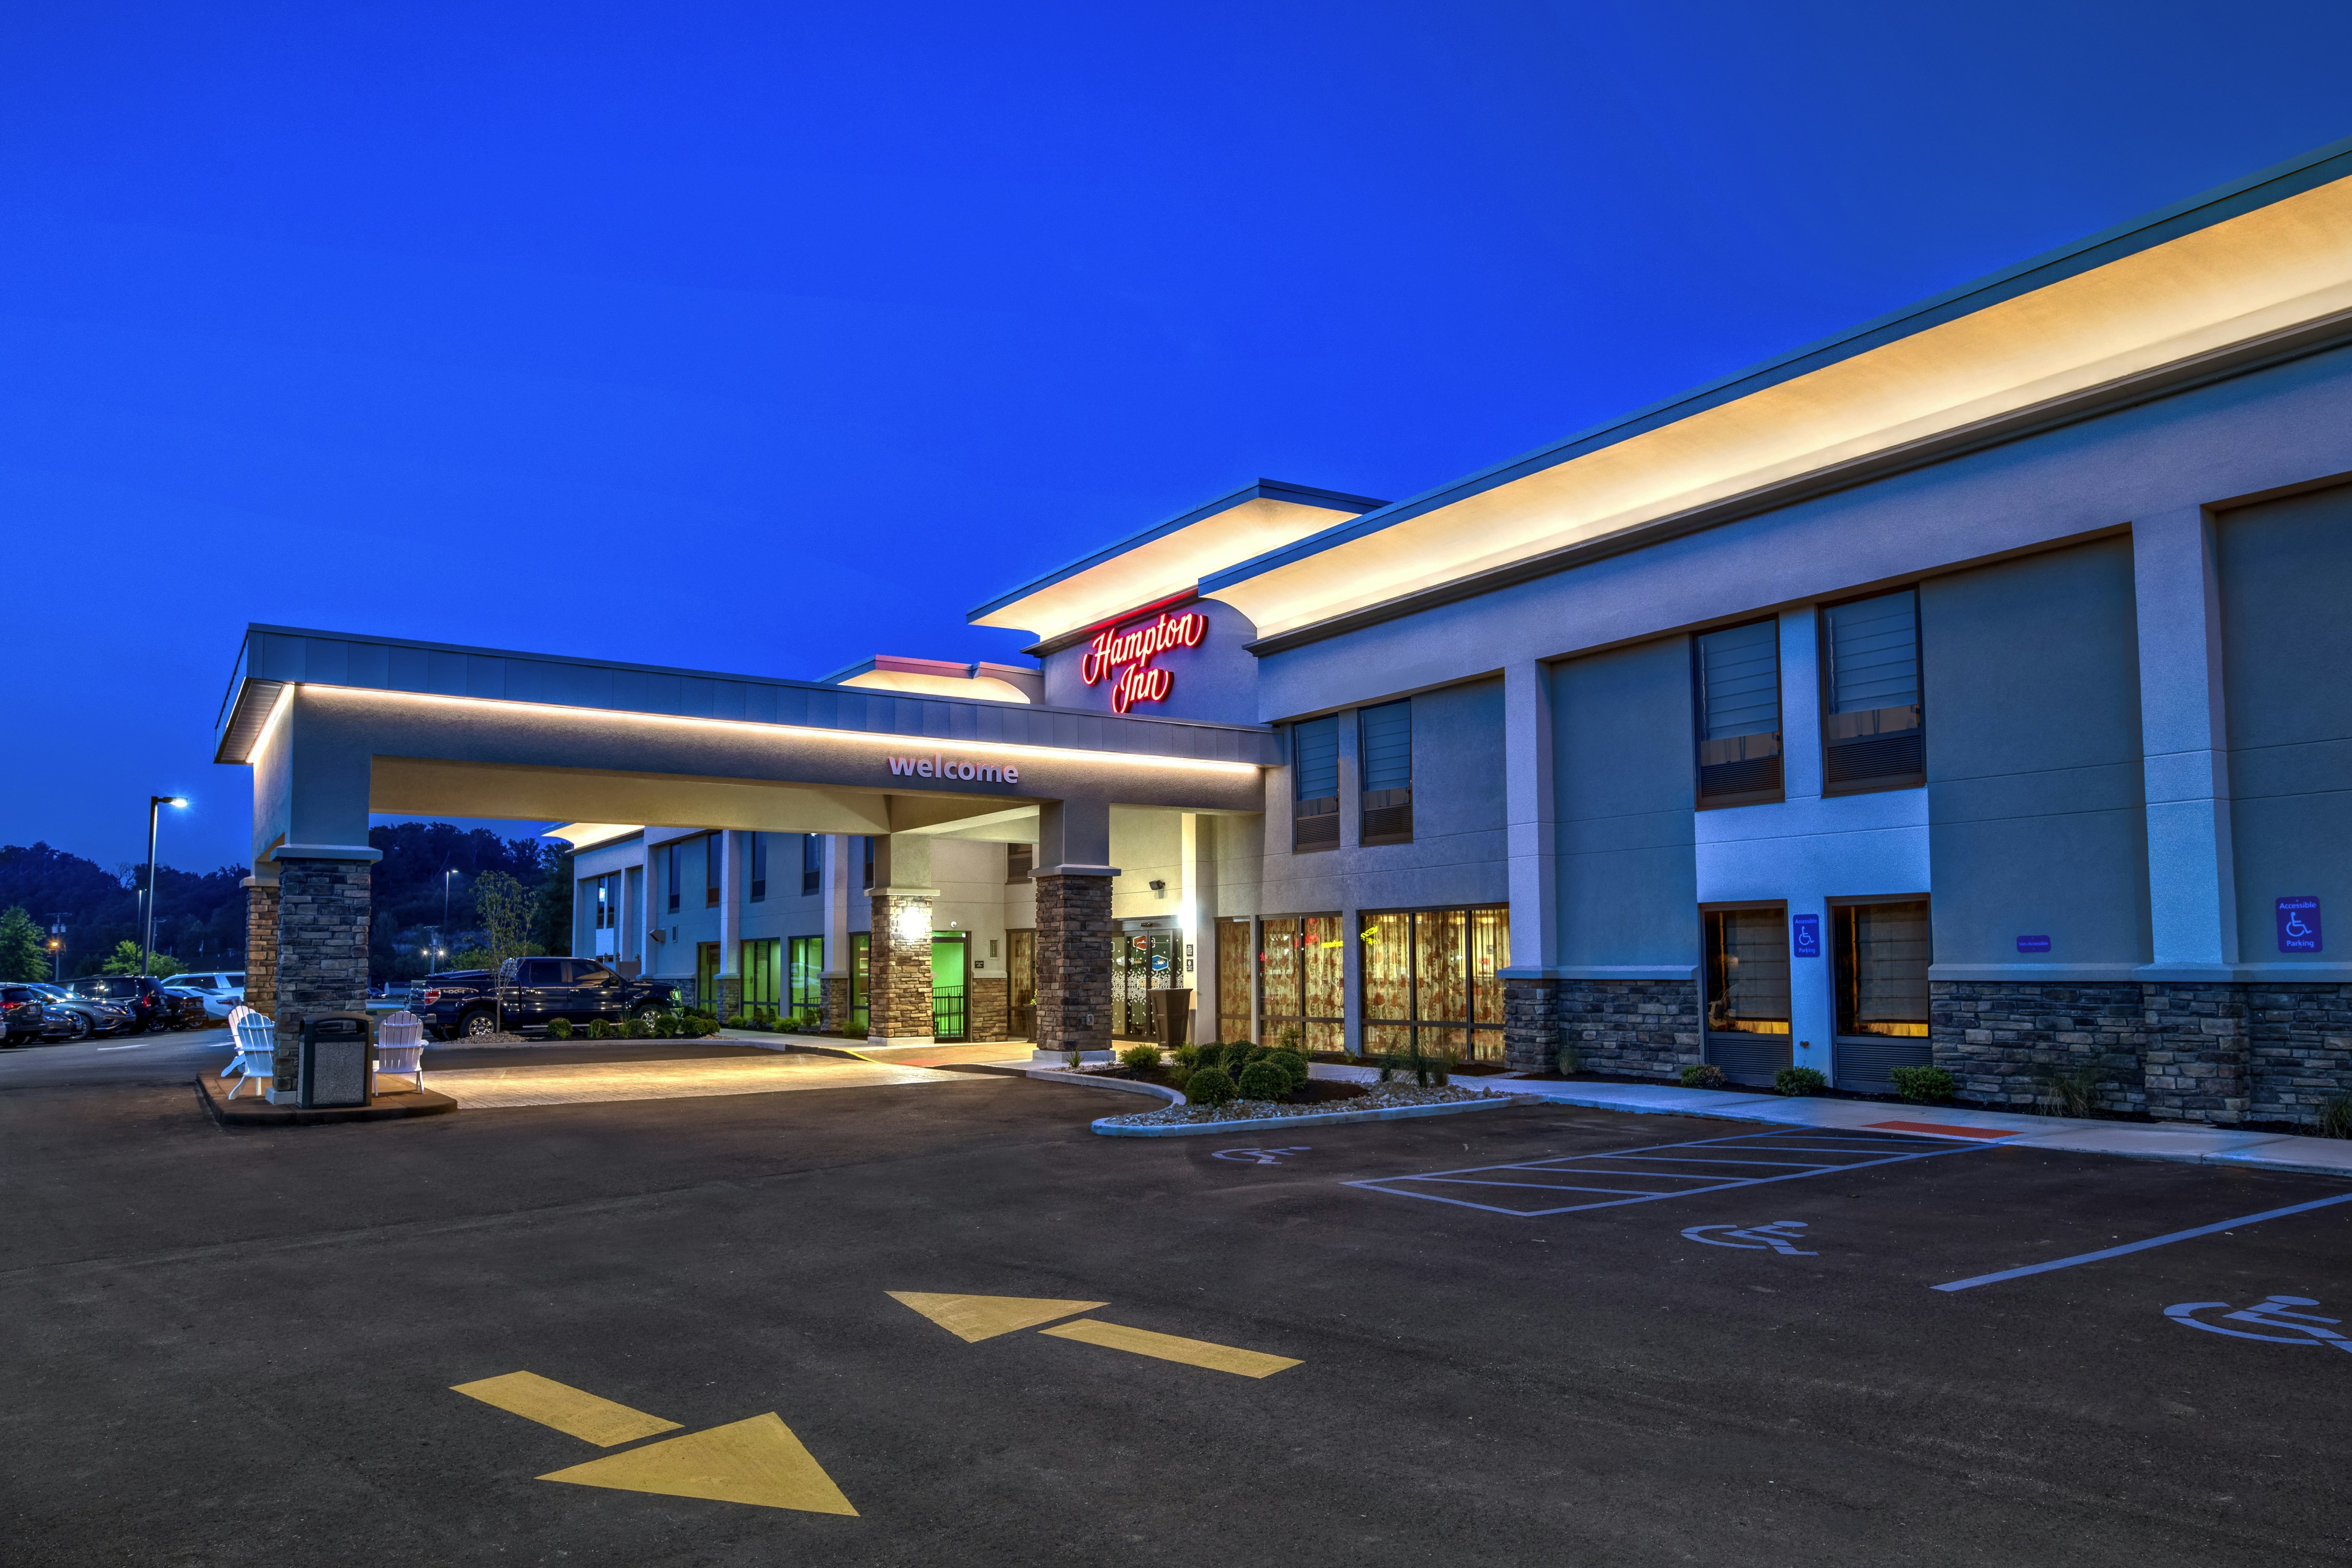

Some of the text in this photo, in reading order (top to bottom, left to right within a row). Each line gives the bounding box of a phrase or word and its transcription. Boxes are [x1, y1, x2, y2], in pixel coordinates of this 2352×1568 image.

[1082, 613, 1208, 685] Hampton
[1112, 663, 1174, 714] Inn
[888, 752, 1019, 783] welcome
